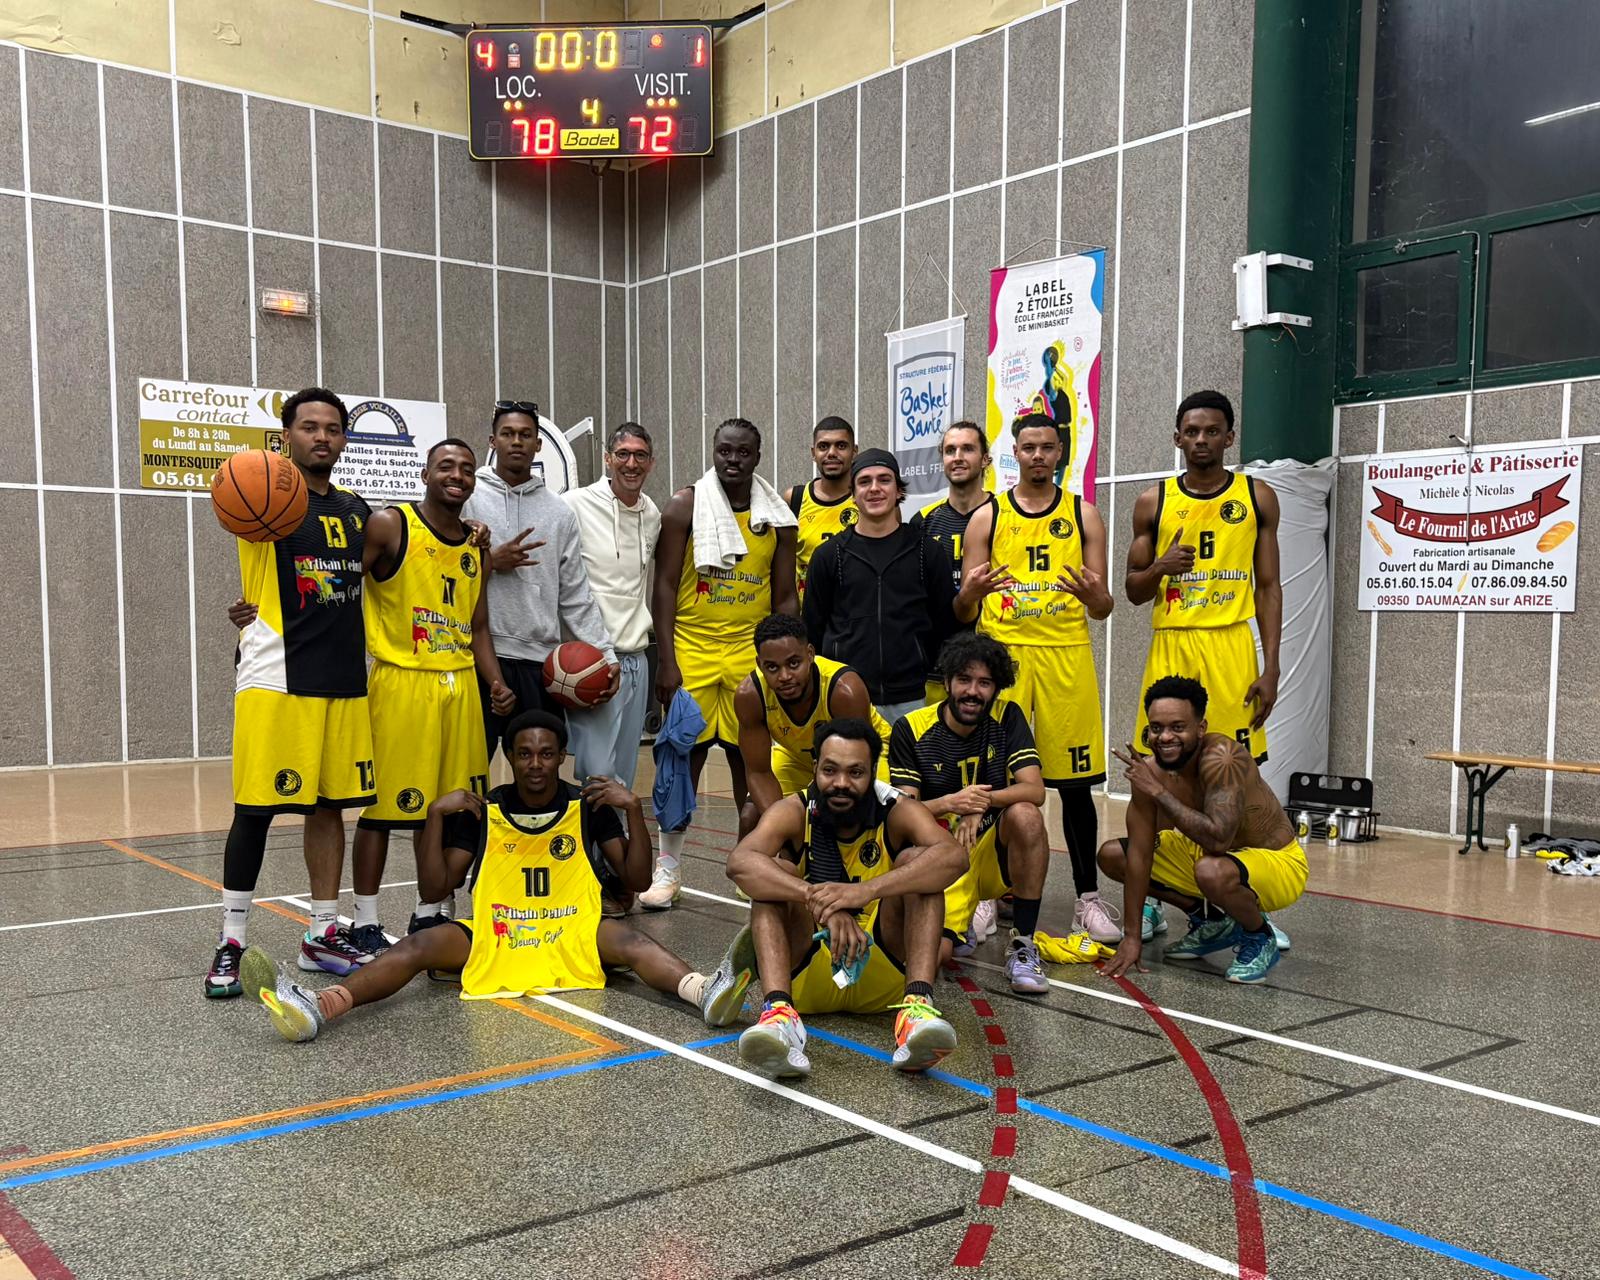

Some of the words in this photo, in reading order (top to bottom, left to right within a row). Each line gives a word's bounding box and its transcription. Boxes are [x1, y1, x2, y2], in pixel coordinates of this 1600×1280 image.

[477, 43, 493, 68] 4
[495, 76, 542, 99] LOC.
[635, 73, 691, 96] VISIT.
[581, 99, 599, 124] 4
[512, 119, 554, 154] 78
[564, 131, 616, 146] Bodet
[629, 117, 672, 152] 72
[1025, 279, 1066, 297] LABEL
[1016, 302, 1024, 314] 2
[1027, 292, 1074, 312] ÉTOILES
[1014, 312, 1036, 324] ÉCOLE
[1036, 306, 1074, 322] FRANÇAISE
[1017, 324, 1027, 333] DE
[1028, 317, 1069, 331] MINIBASKET
[899, 368, 927, 380] STRUCTURE
[927, 363, 953, 375] FÉDÉRALE
[141, 382, 250, 409] Carrefour
[900, 380, 950, 417] Basket
[176, 408, 250, 425] contact
[369, 402, 406, 434] VOLAILLES
[903, 410, 944, 442] Santé
[173, 426, 186, 438] De
[188, 428, 201, 439] 8h
[203, 428, 210, 439] à
[212, 429, 231, 441] 20h
[152, 438, 166, 449] du
[168, 438, 197, 451] Lundi
[199, 443, 212, 452] au
[214, 442, 250, 453] Samedi
[375, 448, 419, 458] fermières
[332, 466, 356, 475] 09130
[360, 468, 420, 479] CARLA-BAYLE
[344, 456, 373, 466] Rouge
[375, 458, 388, 466] du
[389, 459, 427, 468] Sud-Oue
[899, 465, 928, 478] LABEL
[1367, 459, 1467, 481] Boulangerie
[1470, 457, 1485, 474] &
[1490, 451, 1579, 474] Pâtisserie
[339, 477, 417, 489] 05.61.67.13.19
[1419, 486, 1460, 500] Michèle
[1463, 485, 1472, 497] &
[1475, 484, 1515, 497] Nicolas
[318, 515, 349, 548] 13
[1398, 511, 1415, 530] Le
[1418, 516, 1467, 539] Fournil
[1471, 521, 1487, 538] de
[1491, 508, 1537, 534] l'Arize
[1200, 531, 1215, 560] 6
[1413, 547, 1466, 559] Fabrication
[1467, 546, 1516, 557] artisanale
[302, 557, 342, 571] Artisan
[1025, 544, 1051, 573] 15
[1378, 560, 1417, 573] Ouvert
[1419, 560, 1434, 573] du
[1437, 559, 1470, 572] Mardi
[1473, 561, 1488, 572] au
[1492, 559, 1555, 572] Dimanche
[1366, 577, 1453, 589] 05.61.60.15.04
[1471, 575, 1567, 589] 07.86.09.84.50
[1377, 595, 1410, 607] 09350
[1416, 594, 1487, 607] DAUMAZAN
[1489, 597, 1510, 607] sur
[1513, 594, 1553, 607] ARIZE
[1067, 744, 1092, 773] 15
[355, 759, 375, 792] 13
[957, 756, 980, 789] 17
[521, 867, 551, 898] 10
